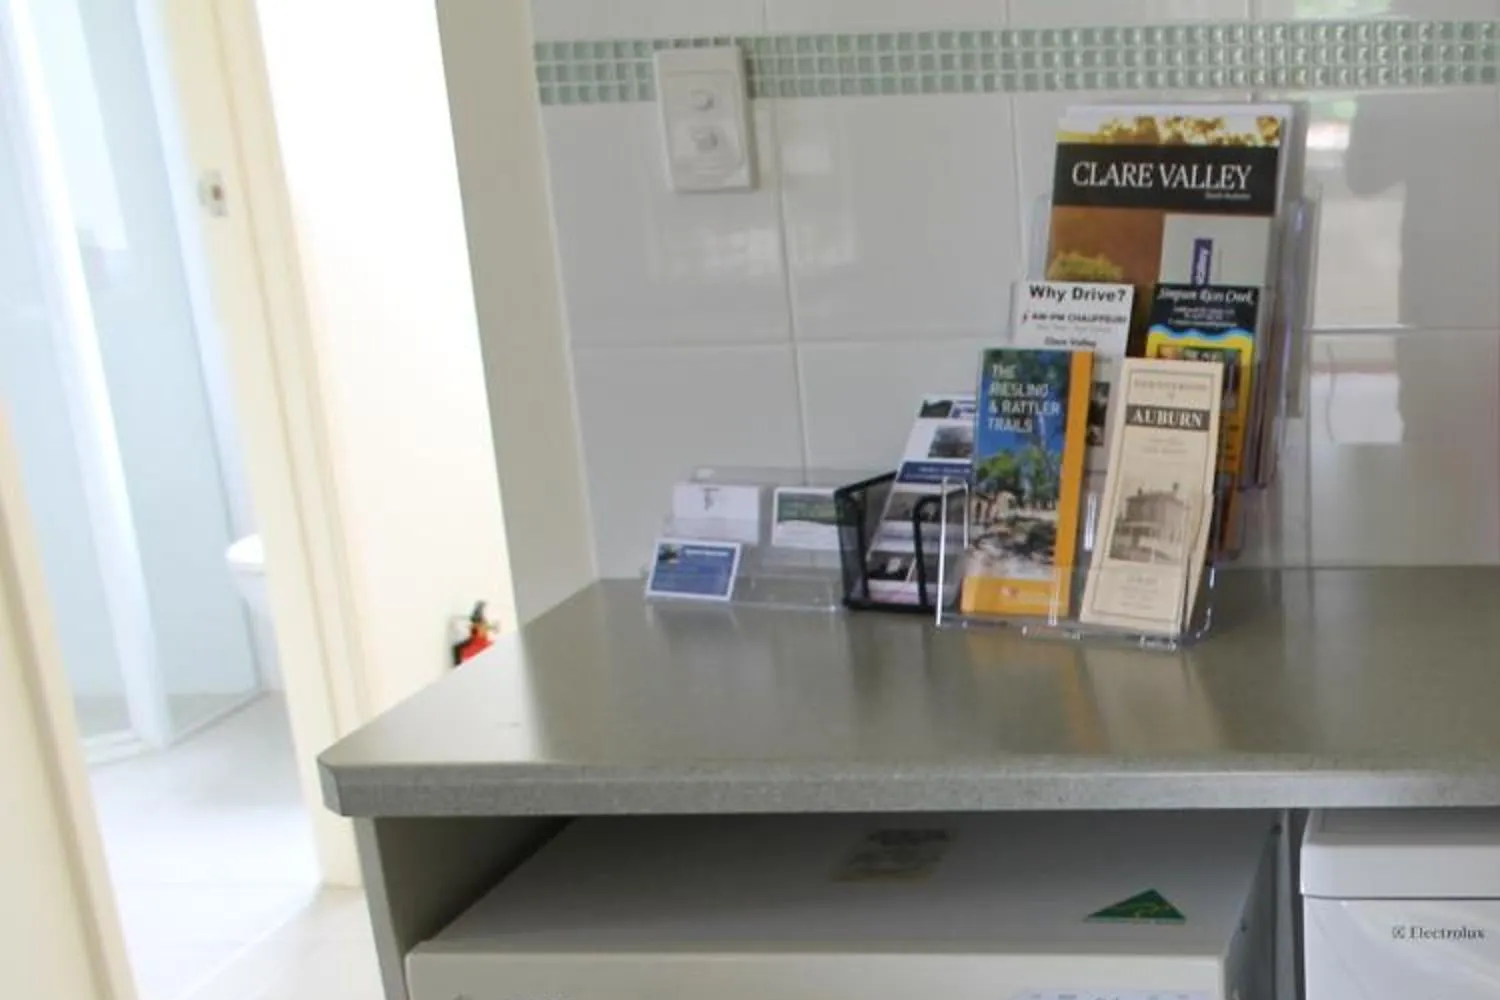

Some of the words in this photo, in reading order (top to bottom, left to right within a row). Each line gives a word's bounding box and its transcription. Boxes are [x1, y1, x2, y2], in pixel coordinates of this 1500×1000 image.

[1071, 160, 1154, 188] CLARE
[1158, 163, 1253, 190] VALLEY
[1029, 284, 1066, 303] Why
[1071, 286, 1127, 303] Drive?
[991, 364, 1017, 380] THE
[987, 381, 1049, 399] RIESLING
[1001, 400, 1062, 418] RATTLER
[1133, 408, 1204, 428] AUBURN
[986, 416, 1034, 434] TRAILS
[1409, 925, 1486, 941] Electrolux
